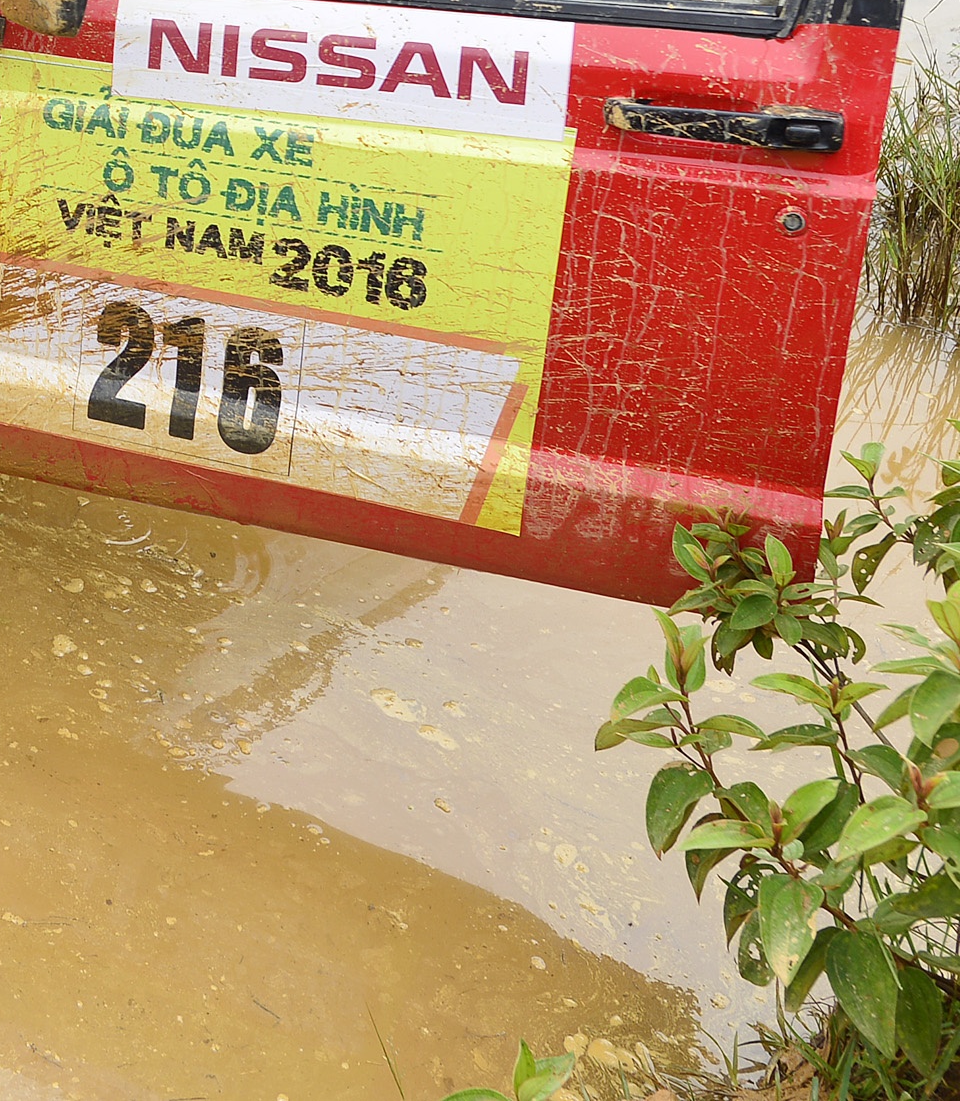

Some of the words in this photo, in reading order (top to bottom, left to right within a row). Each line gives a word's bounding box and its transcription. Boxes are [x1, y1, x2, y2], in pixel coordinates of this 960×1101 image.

[147, 18, 528, 106] NISSAN
[42, 86, 130, 139] GIẢI
[137, 110, 234, 157] ĐUA
[251, 124, 315, 168] XE
[102, 146, 134, 193] Ô
[150, 158, 211, 205] TÔ
[220, 177, 302, 226] ĐỊA
[316, 183, 425, 241] HÌNH
[56, 194, 153, 249] VIỆT
[164, 216, 266, 266] NAM
[269, 237, 429, 312] 2016
[86, 300, 285, 457] 216
